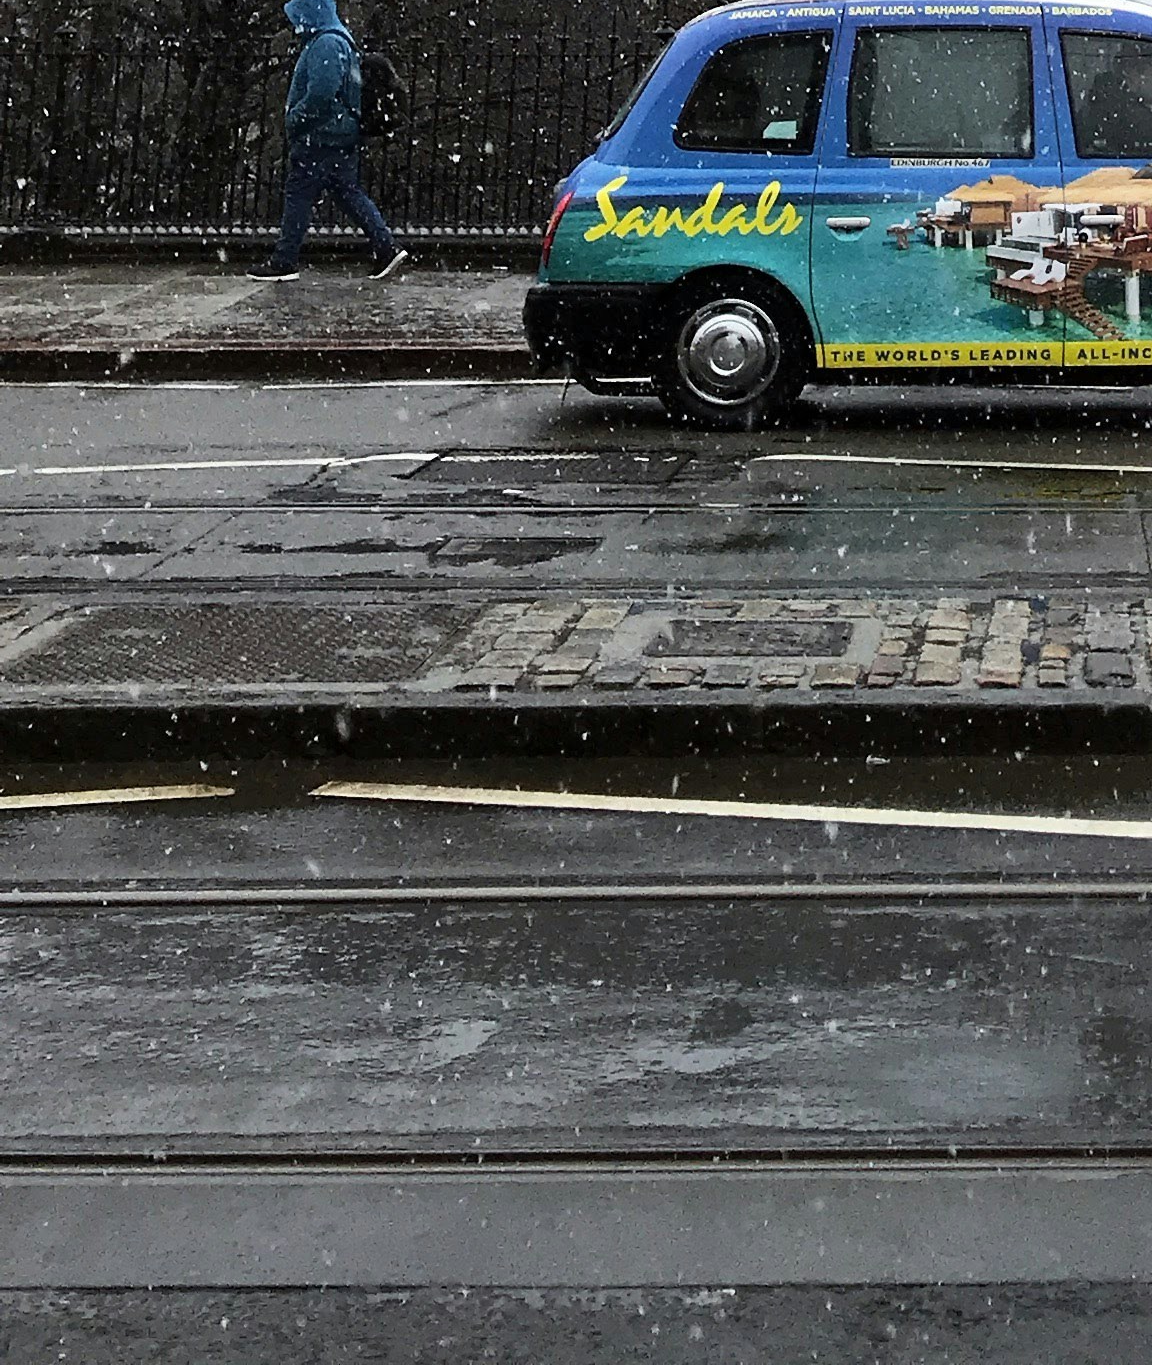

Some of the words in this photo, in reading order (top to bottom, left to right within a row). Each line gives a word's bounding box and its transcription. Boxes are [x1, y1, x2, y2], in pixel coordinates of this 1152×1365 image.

[729, 9, 777, 19] JAMAICA
[786, 7, 836, 17] ANTIGUA
[848, 6, 882, 16] SAINT
[883, 6, 915, 15] LUCIA
[925, 6, 979, 15] BAHAMAS
[988, 6, 1042, 15] GRENADA
[1052, 6, 1112, 16] BARBADOS
[891, 159, 952, 167] EDINBURGH
[971, 159, 990, 167] 467
[583, 175, 803, 242] Sandals
[830, 350, 866, 362] THE
[875, 349, 960, 362] WORLD'S
[969, 349, 1051, 361] LEADING
